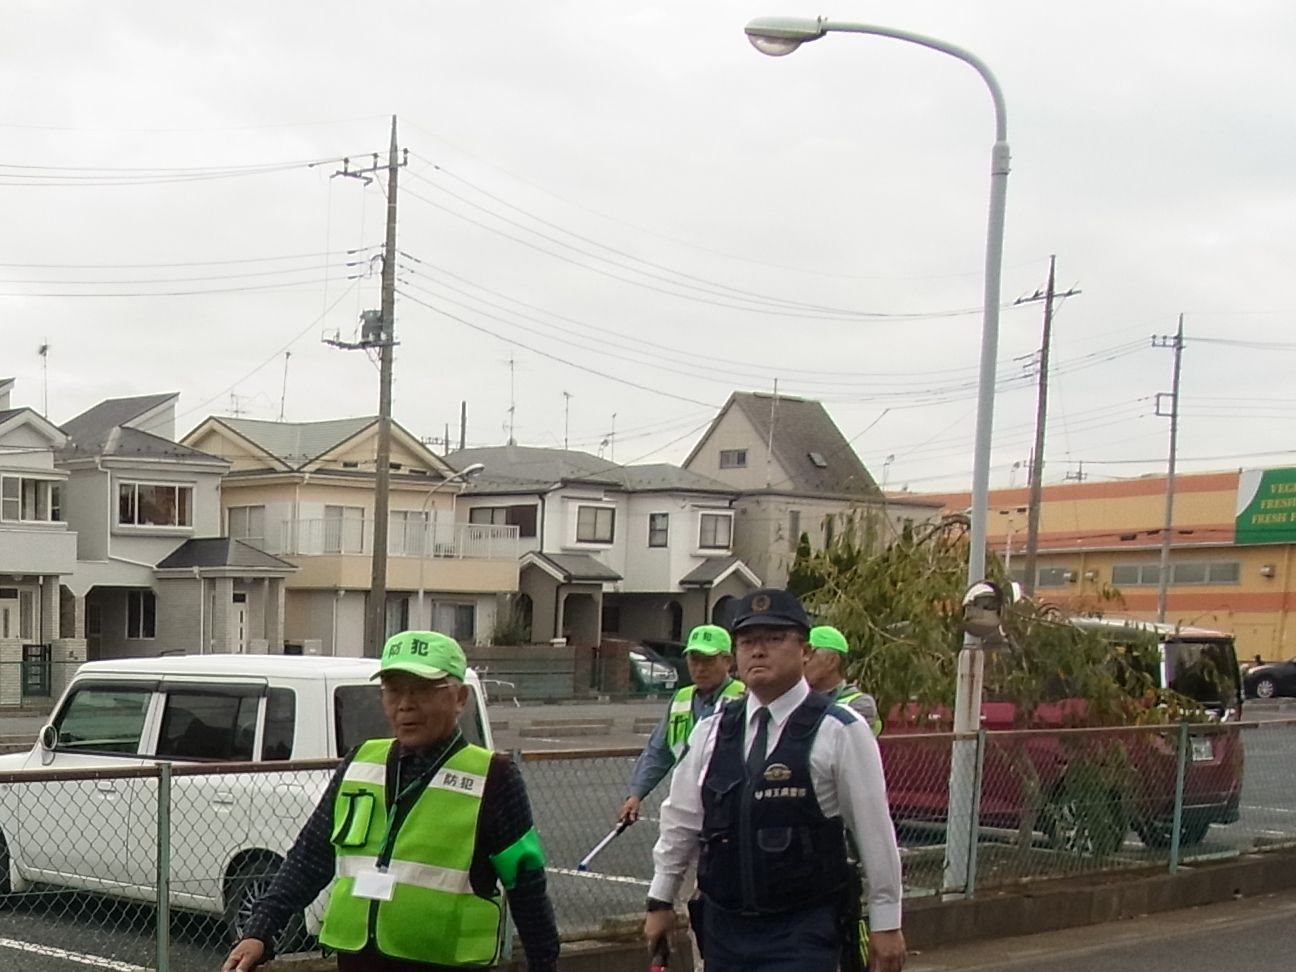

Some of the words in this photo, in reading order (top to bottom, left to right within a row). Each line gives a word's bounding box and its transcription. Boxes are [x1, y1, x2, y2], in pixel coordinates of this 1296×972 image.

[1252, 513, 1286, 524] FRESH
[389, 639, 428, 657] 防犯
[443, 772, 474, 791] 防犯
